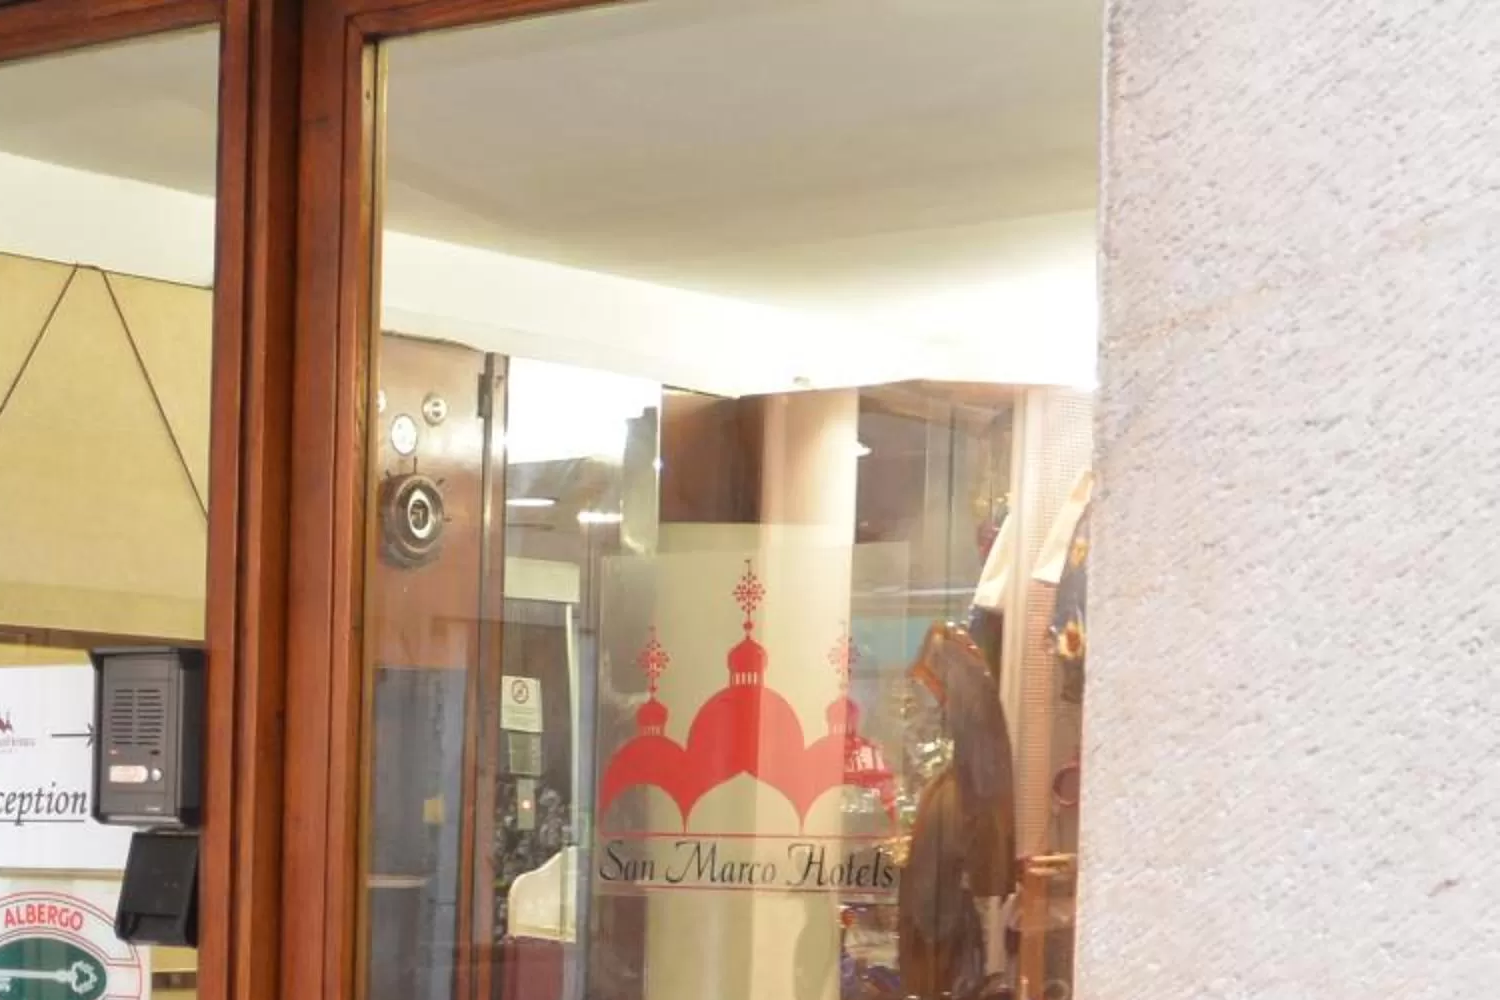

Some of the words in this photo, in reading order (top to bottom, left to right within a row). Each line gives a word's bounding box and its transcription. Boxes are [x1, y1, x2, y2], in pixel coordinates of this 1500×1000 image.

[598, 839, 657, 883] San
[665, 840, 777, 885] Marco
[785, 842, 895, 889] Hotels
[3, 903, 86, 932] ALBERGO
